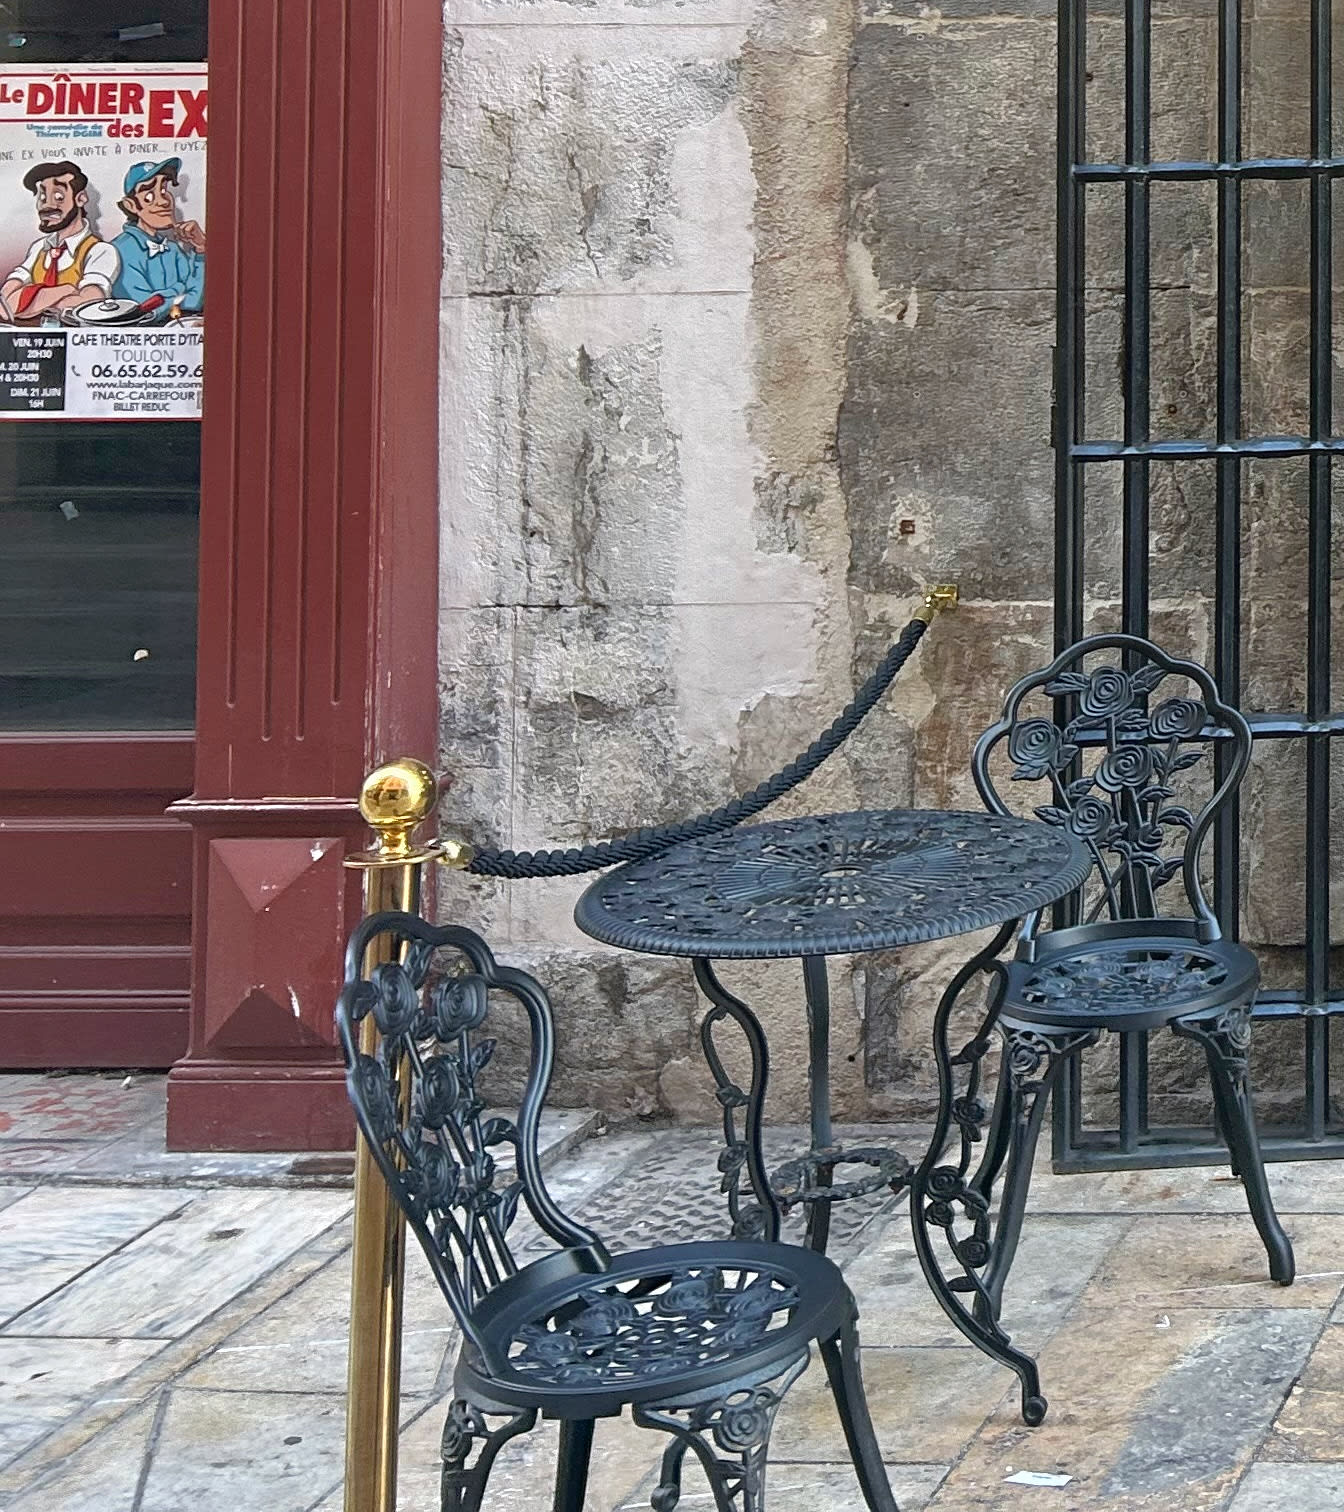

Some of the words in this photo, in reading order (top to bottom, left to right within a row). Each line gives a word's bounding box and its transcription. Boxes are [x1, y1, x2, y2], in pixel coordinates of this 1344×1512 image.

[26, 74, 145, 115] DÎNER
[107, 118, 145, 138] des
[147, 90, 208, 138] EX
[22, 150, 34, 160] EX
[72, 334, 97, 346] CAFE
[100, 334, 141, 346] THEATRE
[144, 334, 176, 346] PORTE
[113, 349, 175, 362] TOULON
[92, 391, 195, 400] FNAC-CARREFOUR
[113, 403, 139, 411] BILLET
[141, 403, 170, 411] REDUC
